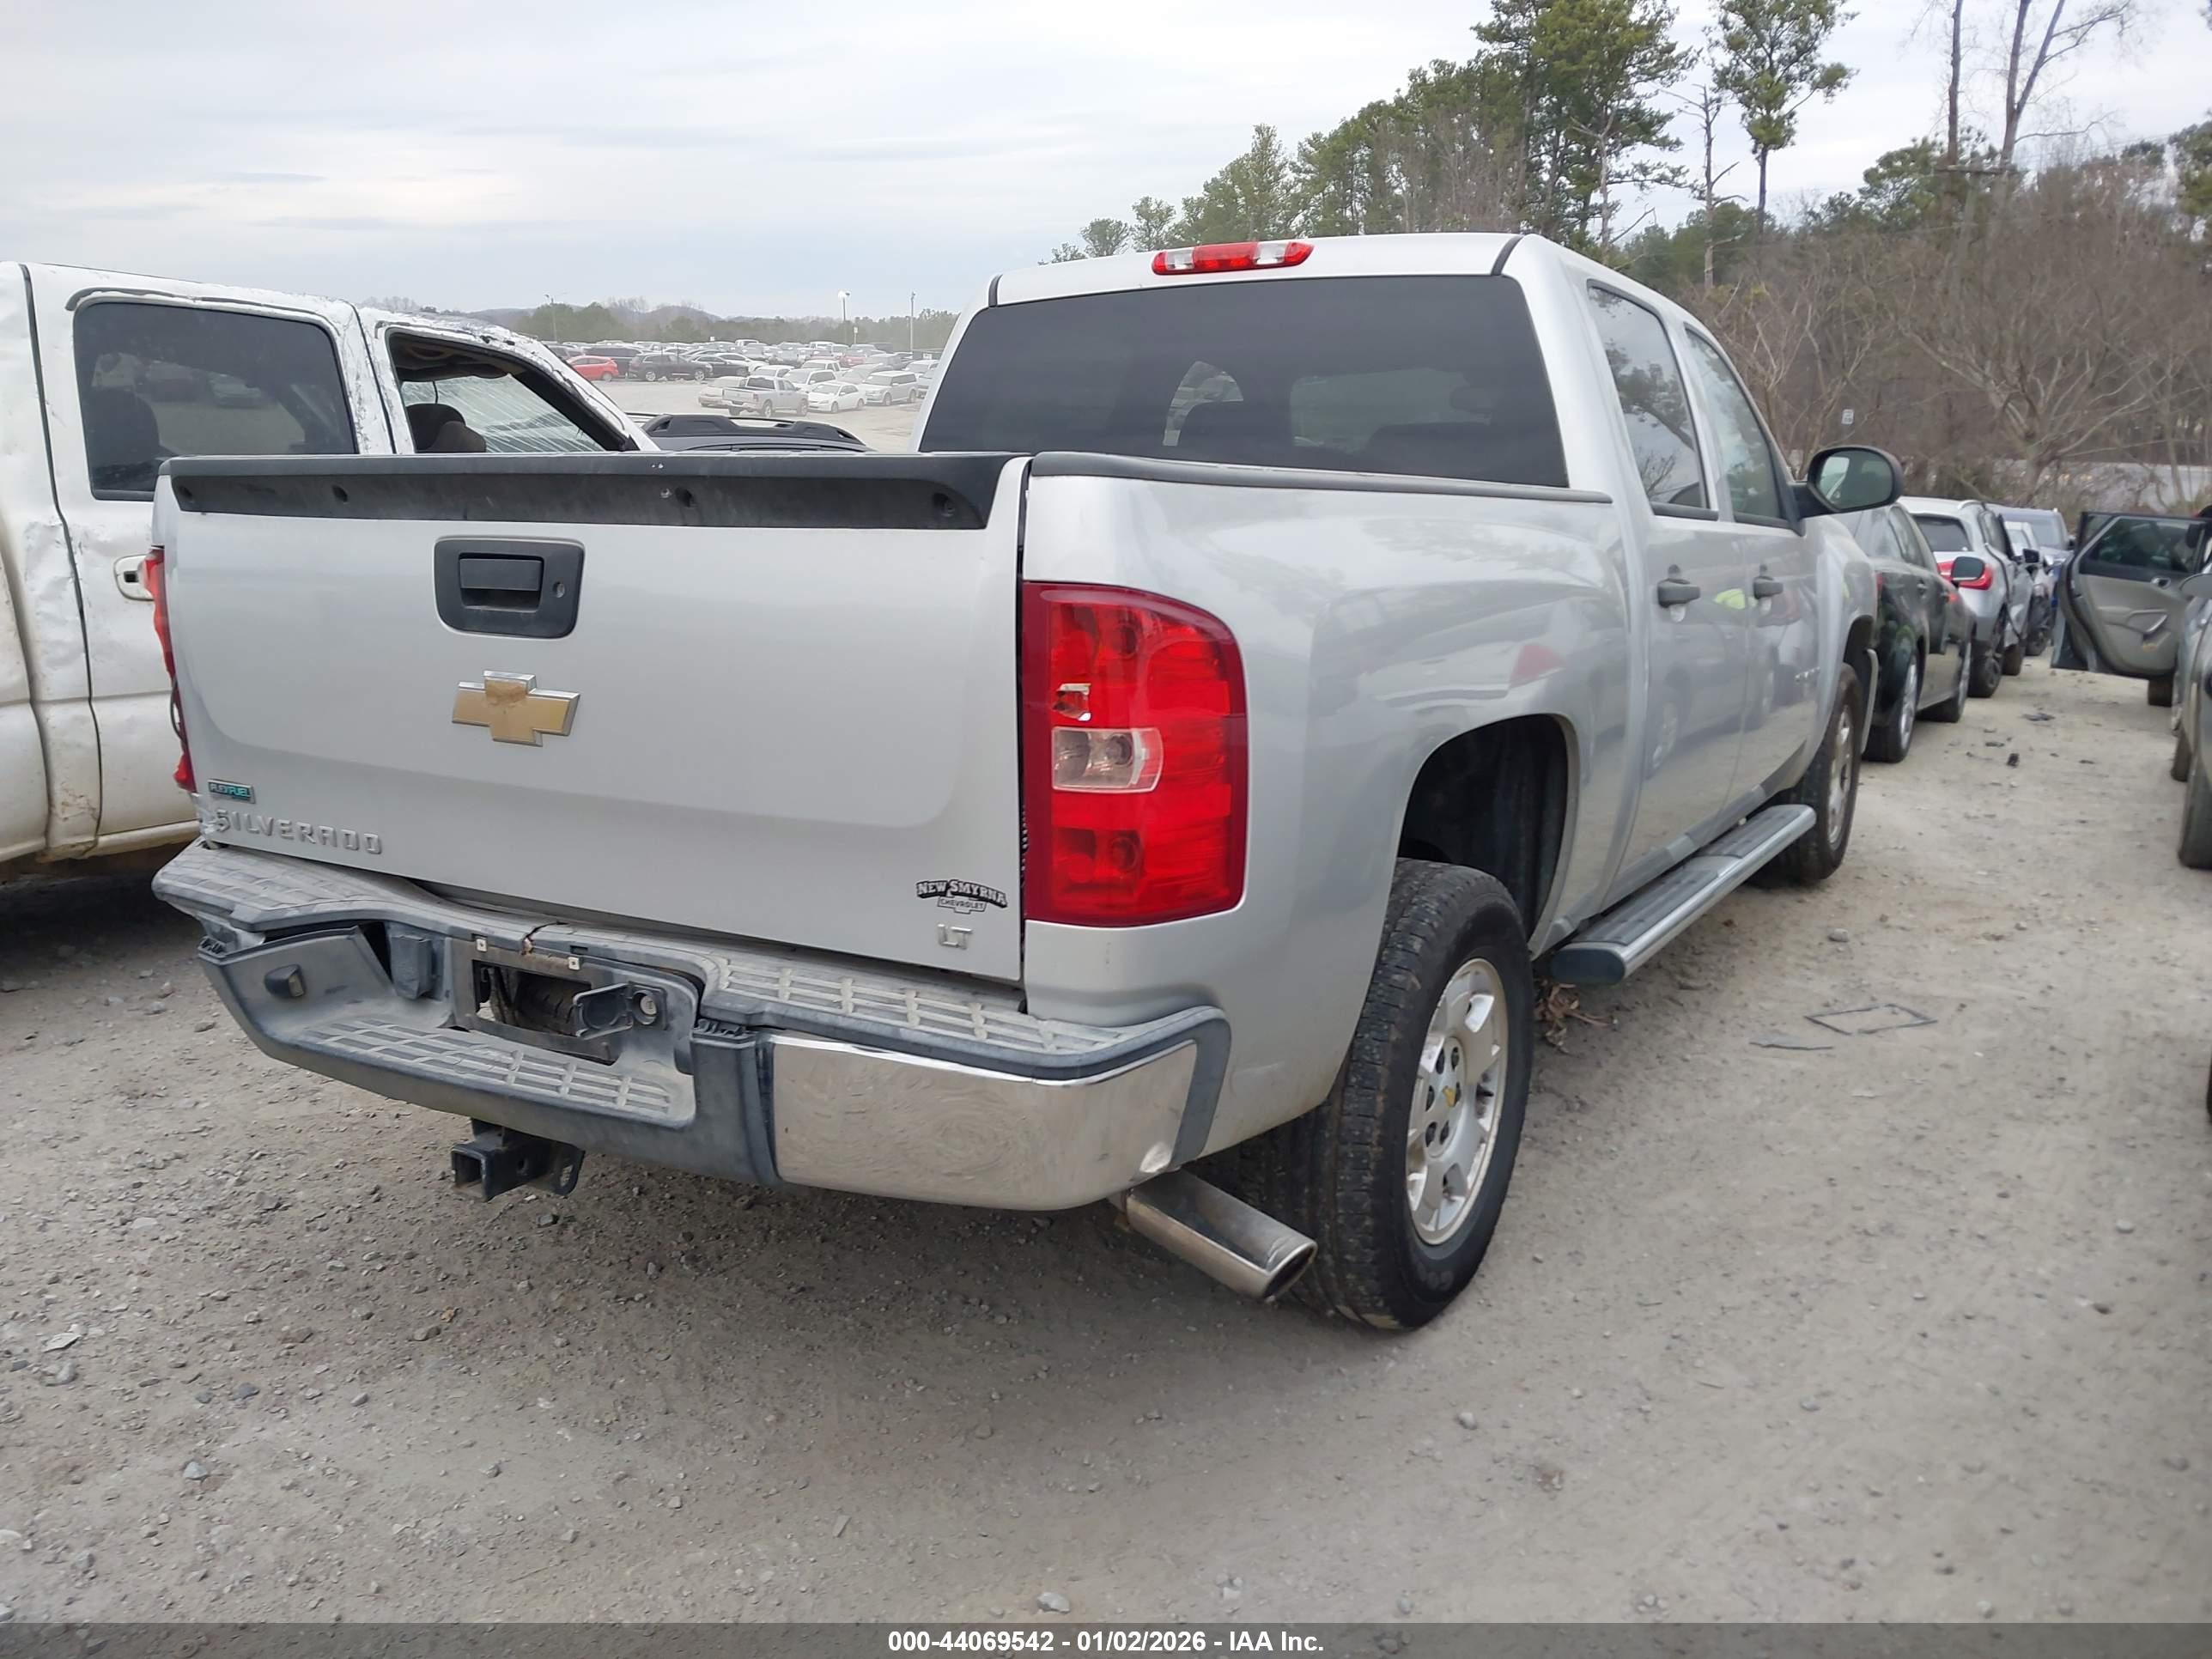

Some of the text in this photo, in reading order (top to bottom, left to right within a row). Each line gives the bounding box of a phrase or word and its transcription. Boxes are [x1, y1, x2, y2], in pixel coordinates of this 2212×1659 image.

[216, 810, 382, 854] SILVERADO
[916, 878, 1008, 908] NEW SMYRNA
[939, 897, 985, 910] CHEVROLET
[937, 923, 972, 950] LT
